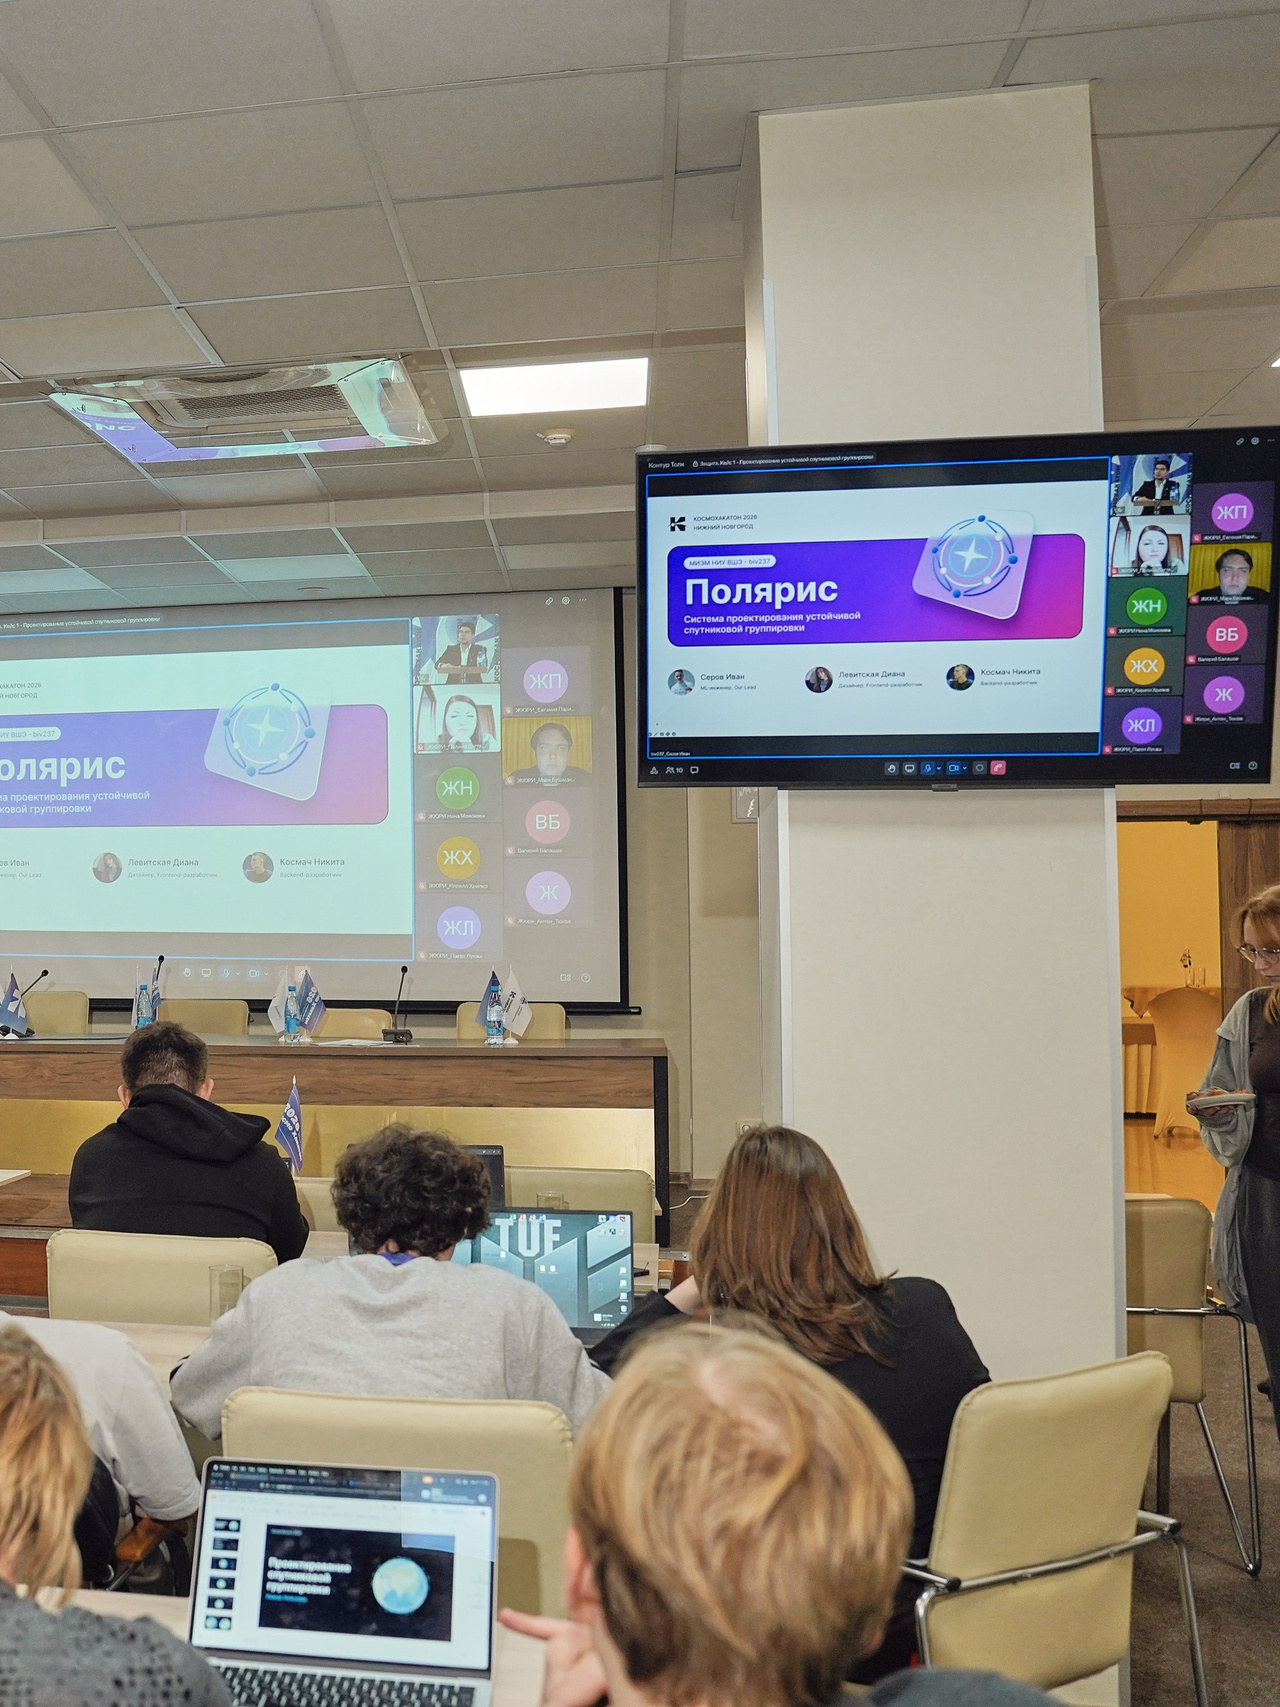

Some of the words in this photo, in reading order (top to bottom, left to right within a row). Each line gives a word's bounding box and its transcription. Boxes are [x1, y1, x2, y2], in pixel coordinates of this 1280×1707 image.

[648, 461, 670, 469] Контур
[671, 460, 685, 468] Толк
[1217, 505, 1248, 520] ЖП
[689, 559, 710, 567] МИЭМ
[711, 559, 726, 567] НИУ
[748, 558, 771, 566] biv237
[686, 578, 838, 610] Полярис
[1132, 600, 1161, 613] ЖН
[23, 620, 64, 629] Проектирование
[64, 619, 94, 627] устойчивой
[95, 617, 126, 626] спутниковой
[127, 616, 161, 625] группировки
[684, 614, 724, 624] Система
[726, 613, 804, 624] проектирования
[805, 611, 861, 623] устойчивой
[684, 624, 743, 635] спутниковой
[745, 624, 805, 635] группировки
[1215, 627, 1239, 642] ВБ
[980, 668, 1011, 677] Космач
[1012, 668, 1041, 676] Никита
[1130, 659, 1158, 673] ЖХ
[529, 673, 562, 689] ЖП
[700, 674, 724, 682] Серов
[726, 673, 745, 681] Иван
[838, 671, 879, 679] Левитская
[880, 670, 906, 679] Диана
[1215, 688, 1233, 702] Ж
[1128, 718, 1155, 733] ЖЛ
[33, 730, 55, 738] biv237
[441, 781, 473, 795] ЖН
[10, 792, 90, 803] проектирования
[92, 790, 150, 802] устойчивой
[29, 804, 92, 815] группировки
[535, 814, 561, 830] ВБ
[9, 859, 30, 867] Иван
[128, 858, 171, 866] Левитская
[172, 858, 199, 867] Диана
[280, 858, 312, 866] Космач
[314, 858, 345, 866] Никита
[443, 850, 473, 865] ЖХ
[280, 871, 342, 879] Backend-разработчик
[539, 885, 558, 900] Ж
[443, 920, 474, 935] ЖЛ
[495, 1218, 562, 1257] TUF
